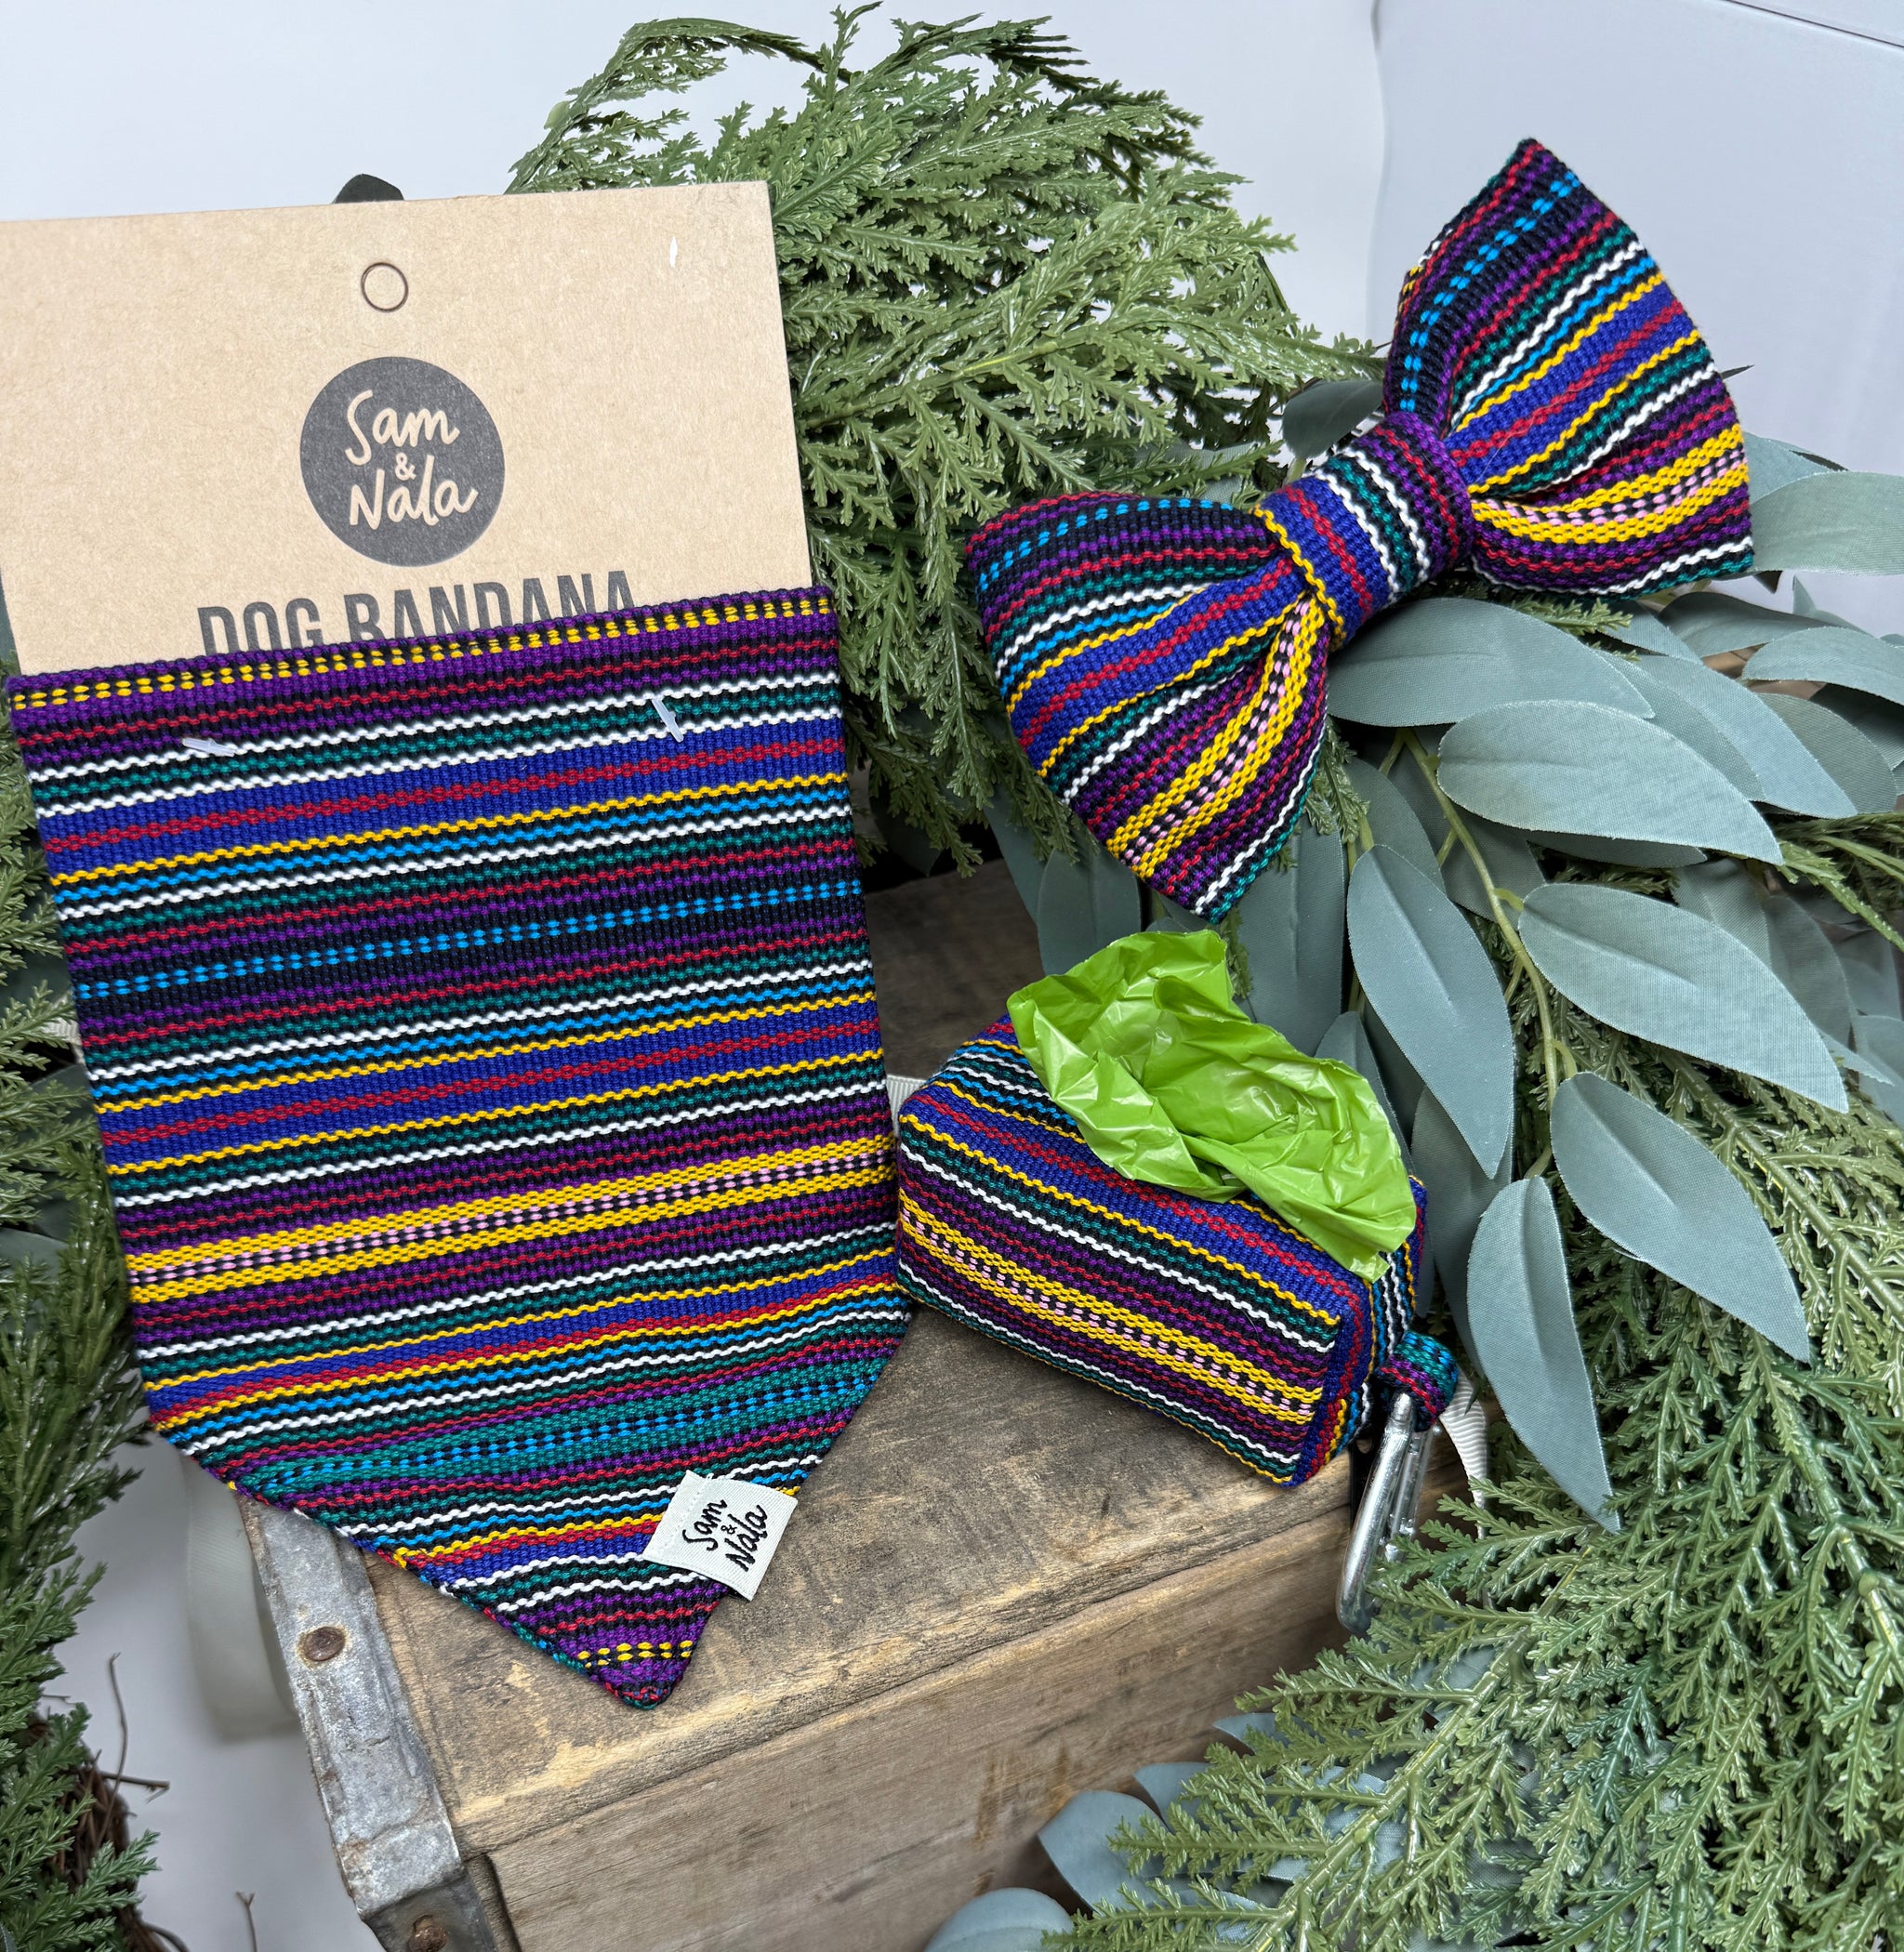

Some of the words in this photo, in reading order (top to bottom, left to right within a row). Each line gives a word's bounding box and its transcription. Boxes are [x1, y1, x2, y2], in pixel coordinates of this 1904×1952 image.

[345, 389, 460, 466] Sam
[349, 455, 479, 530] Nala
[394, 452, 417, 481] &
[197, 598, 324, 657] DOG
[682, 1499, 728, 1551] Sam
[721, 1524, 737, 1535] &
[724, 1505, 768, 1572] Nala
